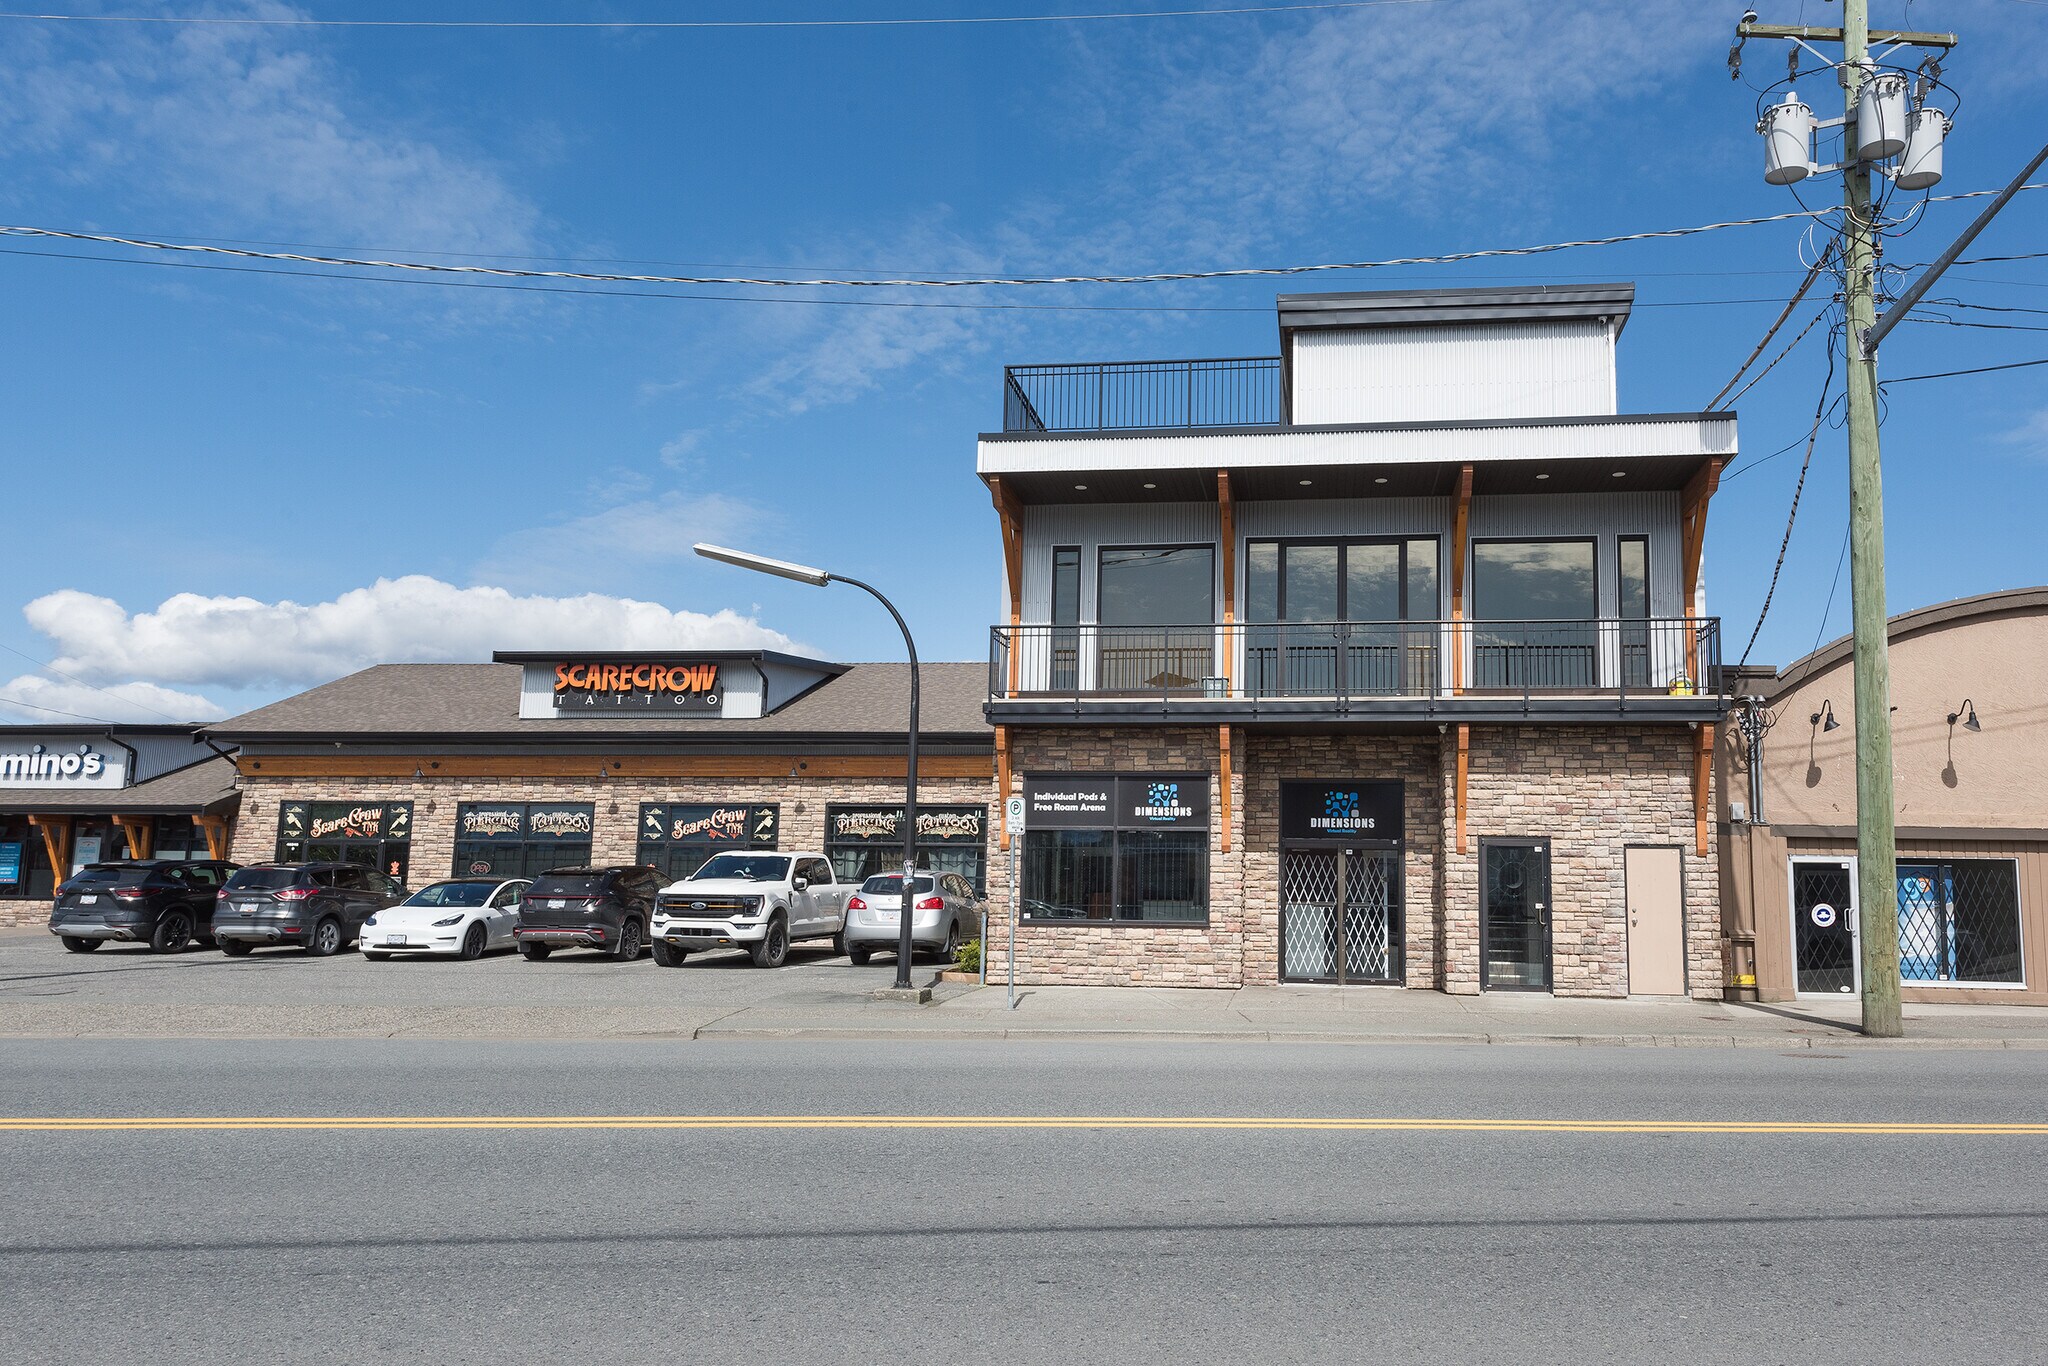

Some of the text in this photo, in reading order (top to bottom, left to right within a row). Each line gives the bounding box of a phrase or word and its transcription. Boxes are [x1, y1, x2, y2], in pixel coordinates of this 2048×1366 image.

[554, 662, 717, 692] SCARECROW
[556, 694, 718, 705] TATTOO
[1034, 792, 1107, 801] Individual Pods &
[1013, 803, 1020, 812] P
[1033, 803, 1106, 811] Free Roam Arena
[1134, 806, 1192, 817] DIMENSIONS
[1310, 817, 1375, 828] DIMENSIONS
[470, 863, 489, 873] OPEN
